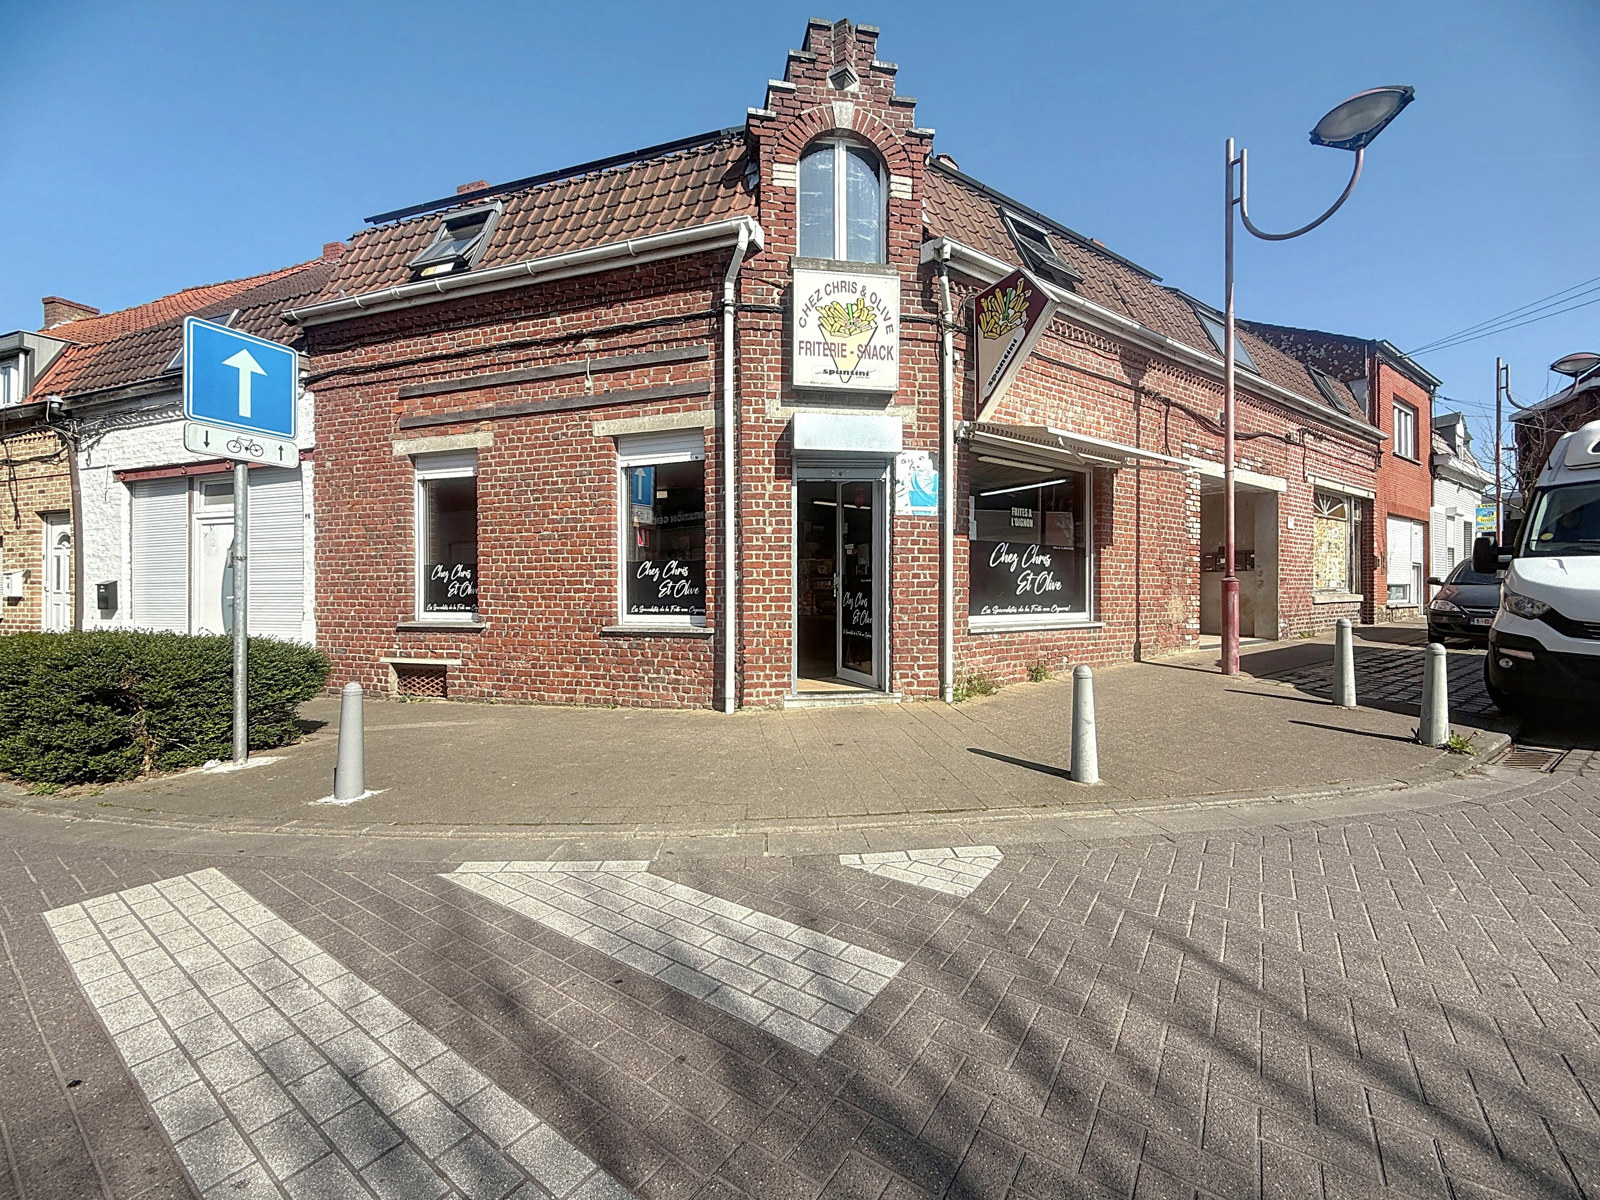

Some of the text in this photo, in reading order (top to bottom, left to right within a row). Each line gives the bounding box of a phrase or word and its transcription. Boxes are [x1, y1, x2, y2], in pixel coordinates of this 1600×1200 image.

[798, 280, 894, 335] CHEZ CHRIS & OLIVE
[798, 340, 847, 358] FRITERIE
[857, 343, 894, 361] SNACK
[822, 368, 869, 377] spuntini
[1011, 507, 1028, 517] FRITES
[989, 542, 1051, 572] Chez Chris
[431, 564, 471, 583] Chez Chris
[637, 560, 689, 582] Chez Chris
[448, 581, 460, 597] Et
[658, 580, 700, 598] Et Olive
[1016, 569, 1062, 595] Et Olive
